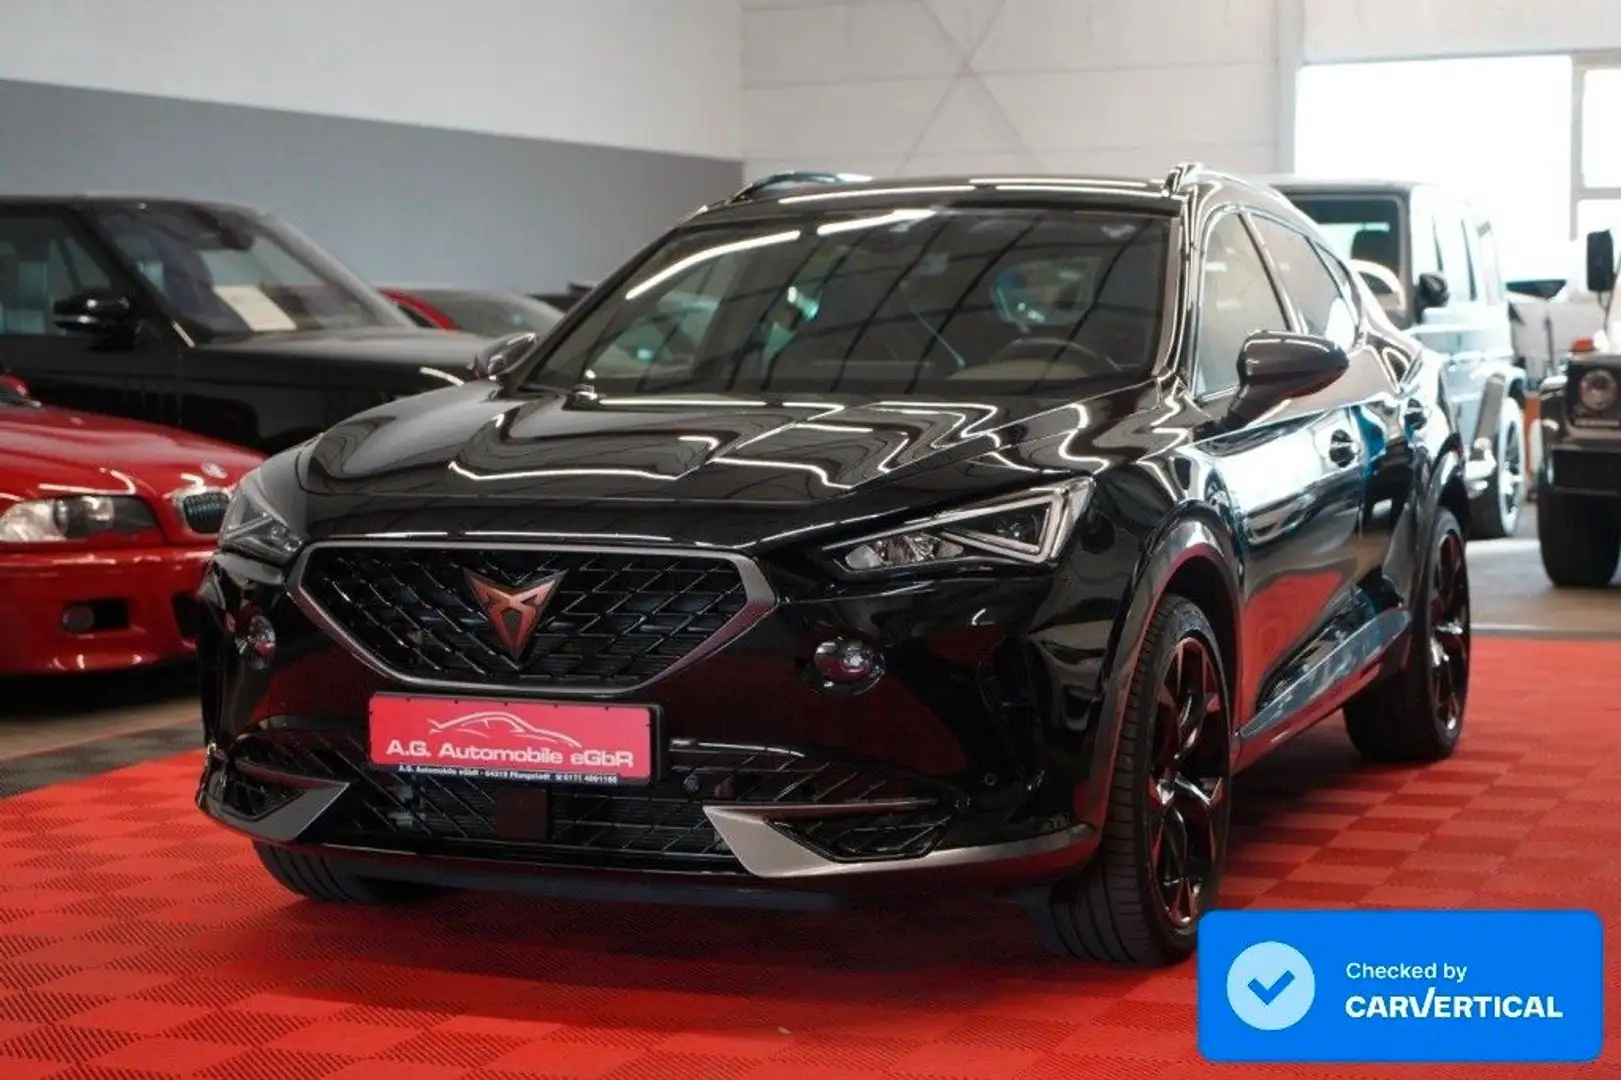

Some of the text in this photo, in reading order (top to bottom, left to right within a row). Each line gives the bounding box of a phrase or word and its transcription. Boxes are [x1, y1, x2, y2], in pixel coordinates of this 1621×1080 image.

[386, 739, 635, 768] A.G. Automobile eGbR
